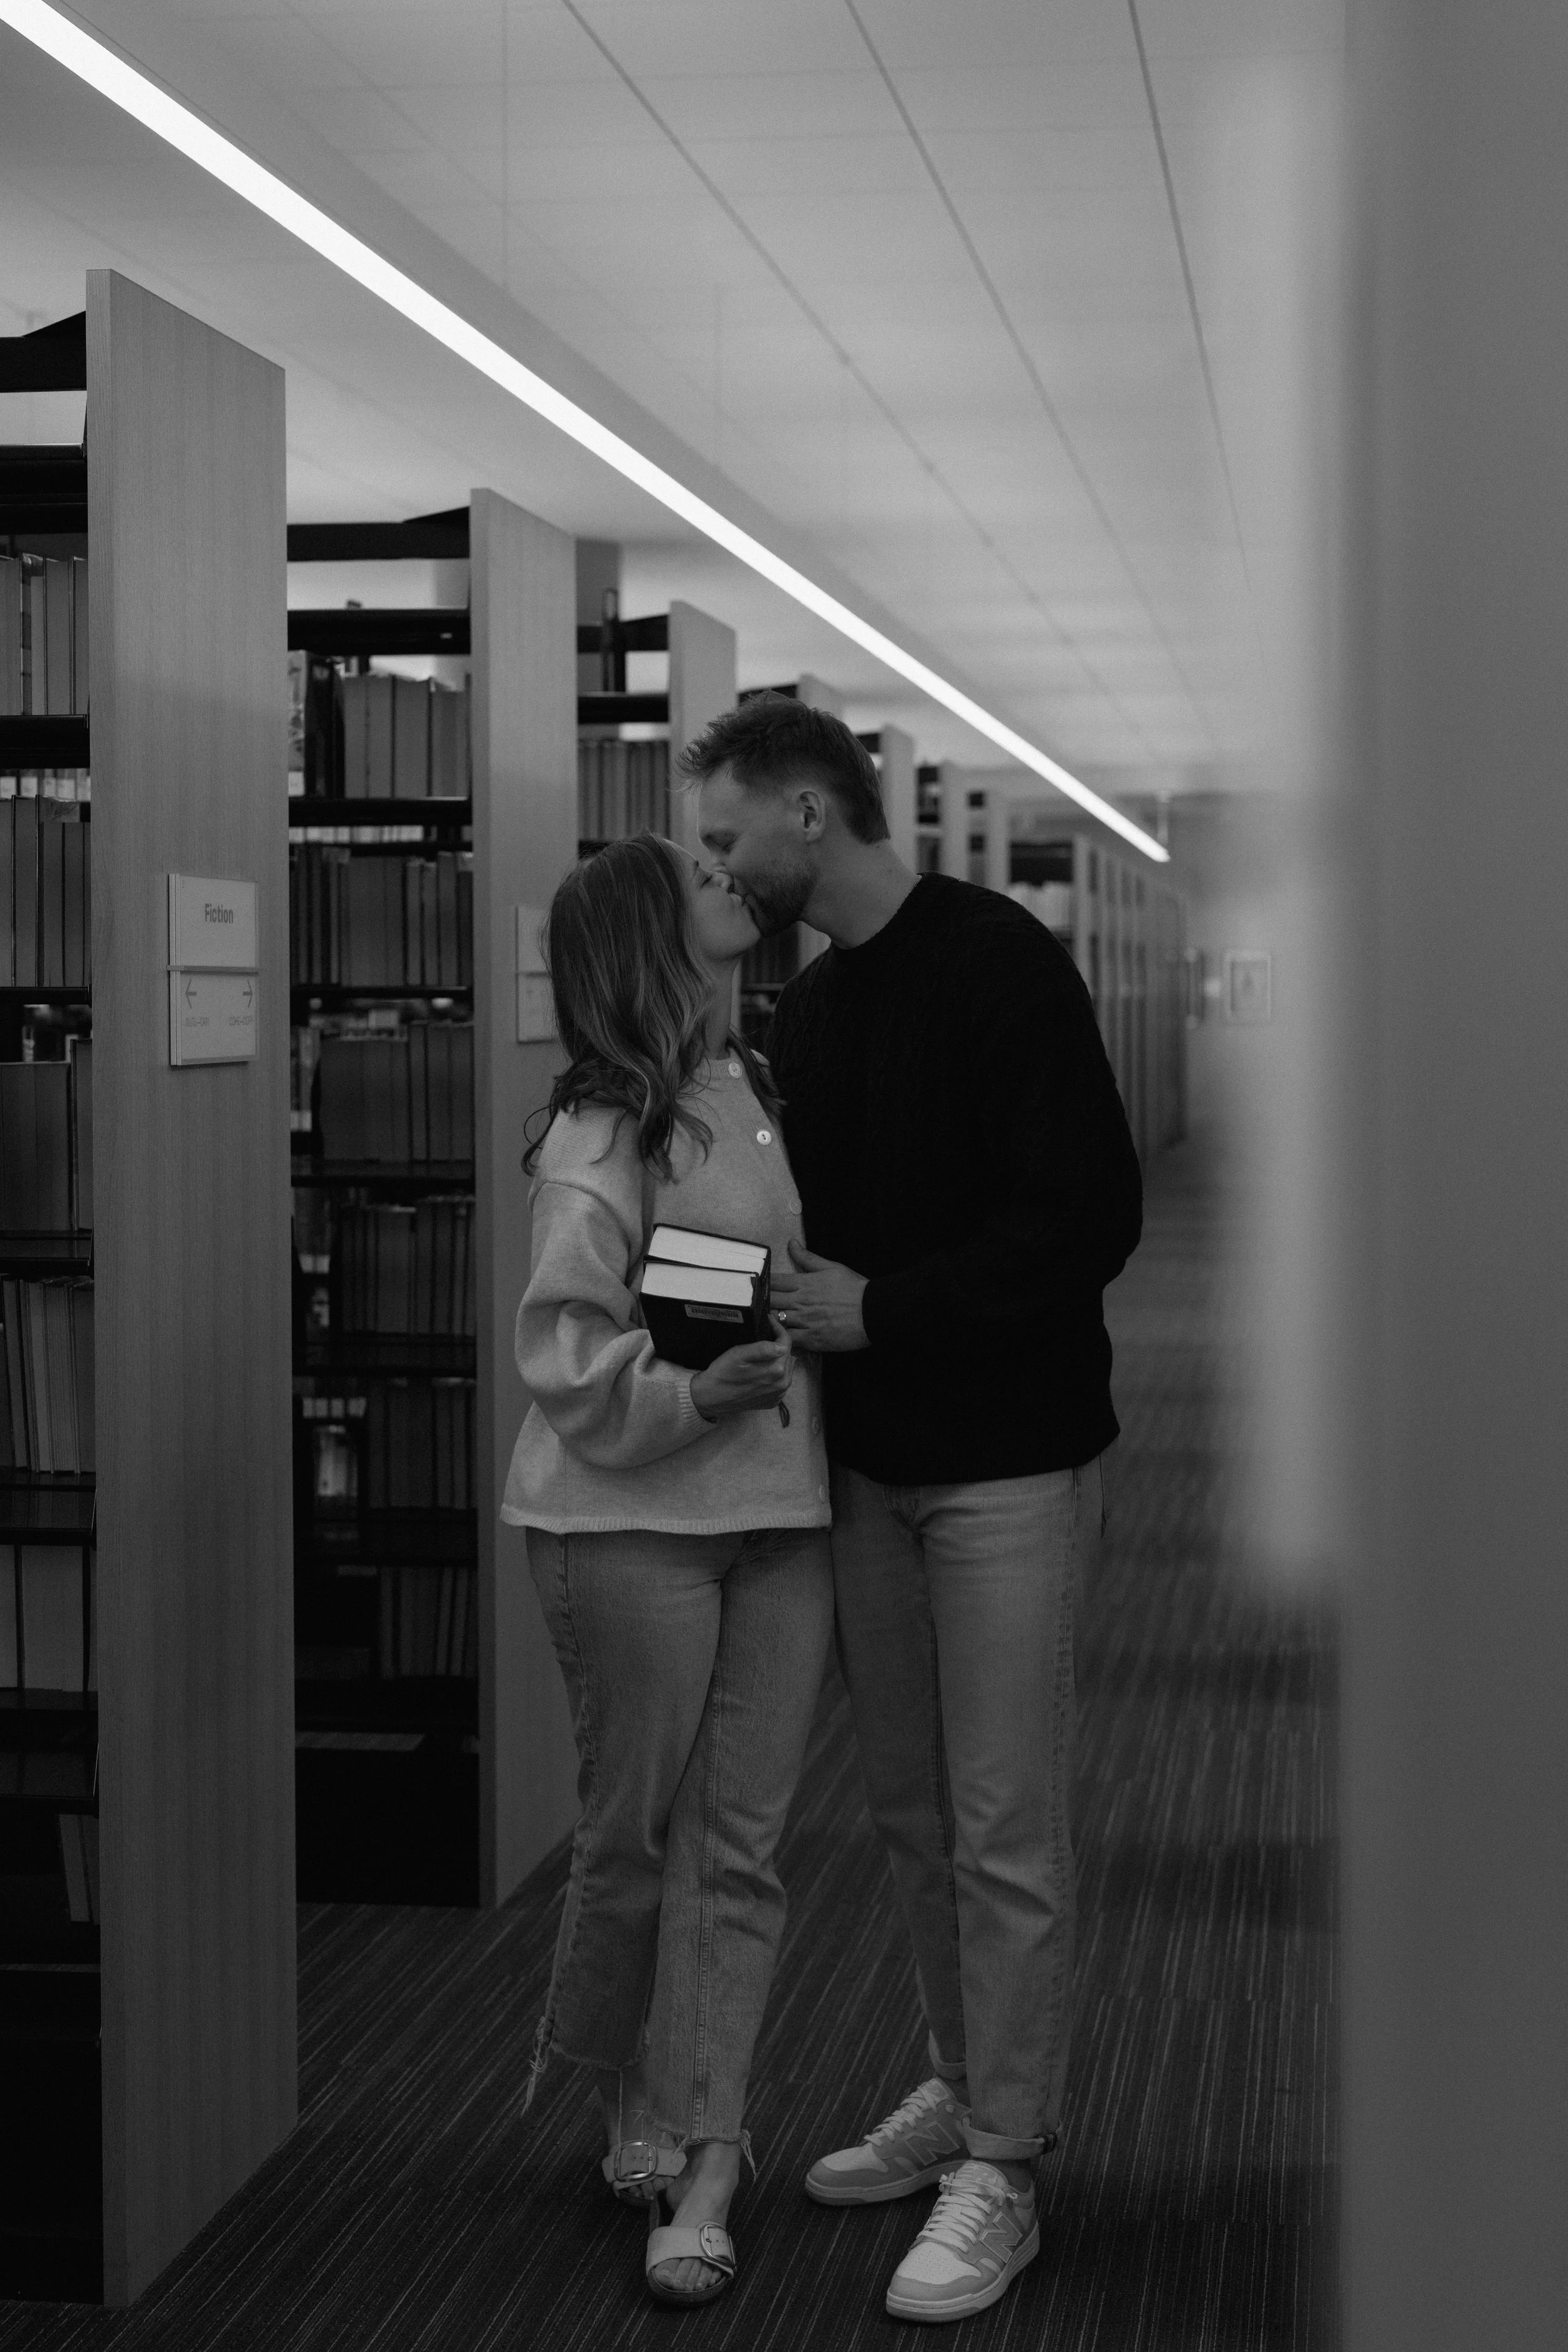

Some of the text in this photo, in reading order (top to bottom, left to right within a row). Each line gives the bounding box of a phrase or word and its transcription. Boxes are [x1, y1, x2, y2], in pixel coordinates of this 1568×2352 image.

[204, 903, 233, 924] Fiction
[904, 2121, 960, 2166] N
[980, 2212, 1023, 2263] N
